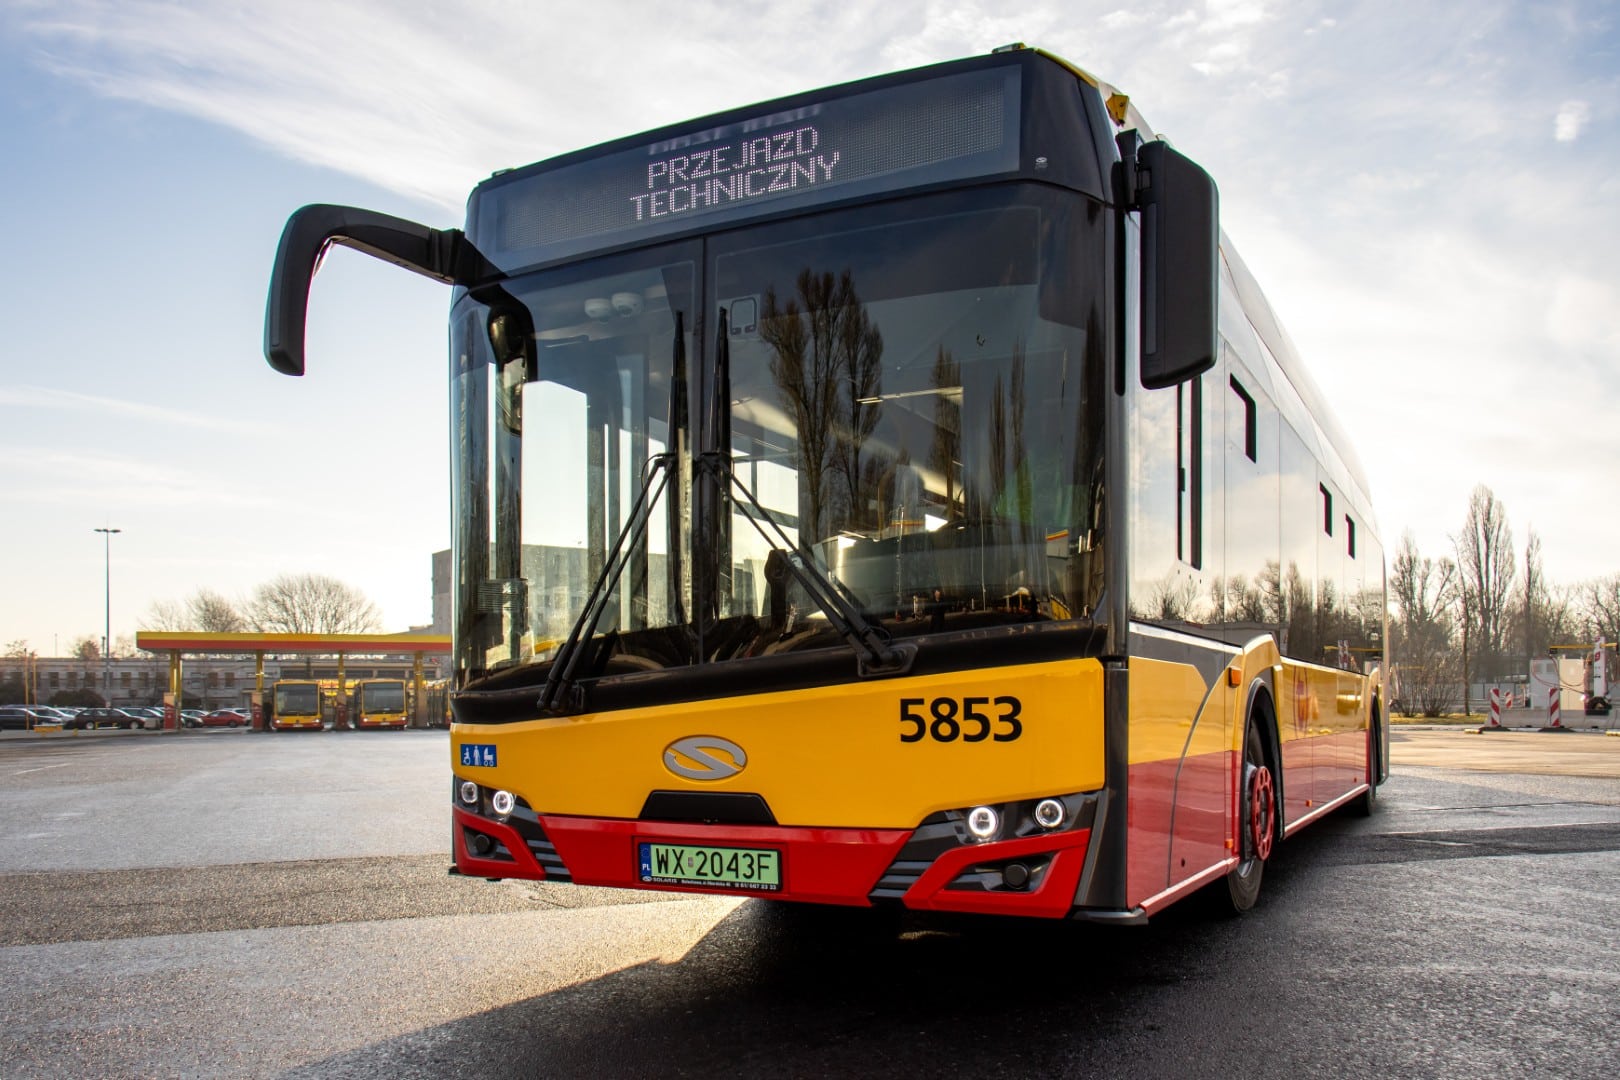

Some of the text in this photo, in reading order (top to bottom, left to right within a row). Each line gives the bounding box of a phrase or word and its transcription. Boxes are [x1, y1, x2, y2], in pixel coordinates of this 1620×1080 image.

[648, 126, 818, 189] PRZEJAZD
[629, 151, 840, 221] TECHNICZNY
[899, 695, 1023, 743] 5853
[642, 863, 651, 871] PL
[652, 876, 678, 884] SOLARIS
[655, 847, 772, 880] WX 2043F
